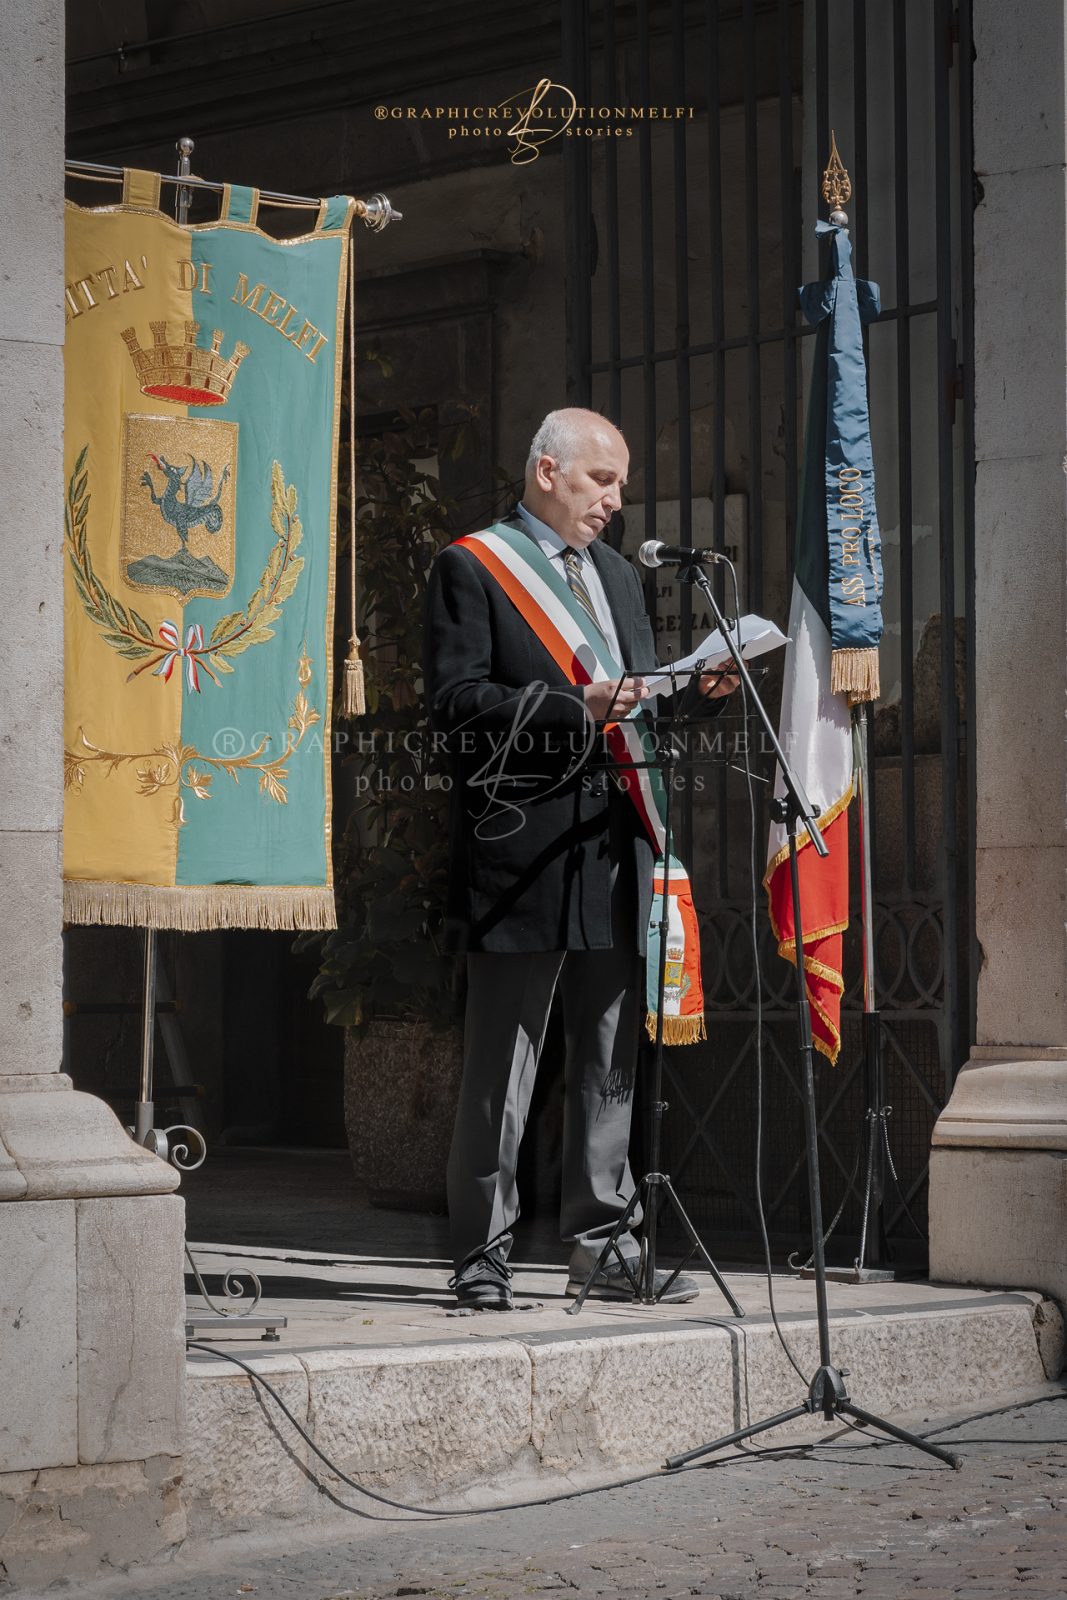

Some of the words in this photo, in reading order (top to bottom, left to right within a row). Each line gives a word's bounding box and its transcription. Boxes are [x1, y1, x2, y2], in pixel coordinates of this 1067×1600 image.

[65, 255, 148, 324] ITTA'
[177, 259, 213, 295] DI
[231, 272, 329, 365] MELFI
[838, 467, 864, 521] LOCO
[841, 526, 862, 567] PRO
[840, 573, 866, 608] ASS.
